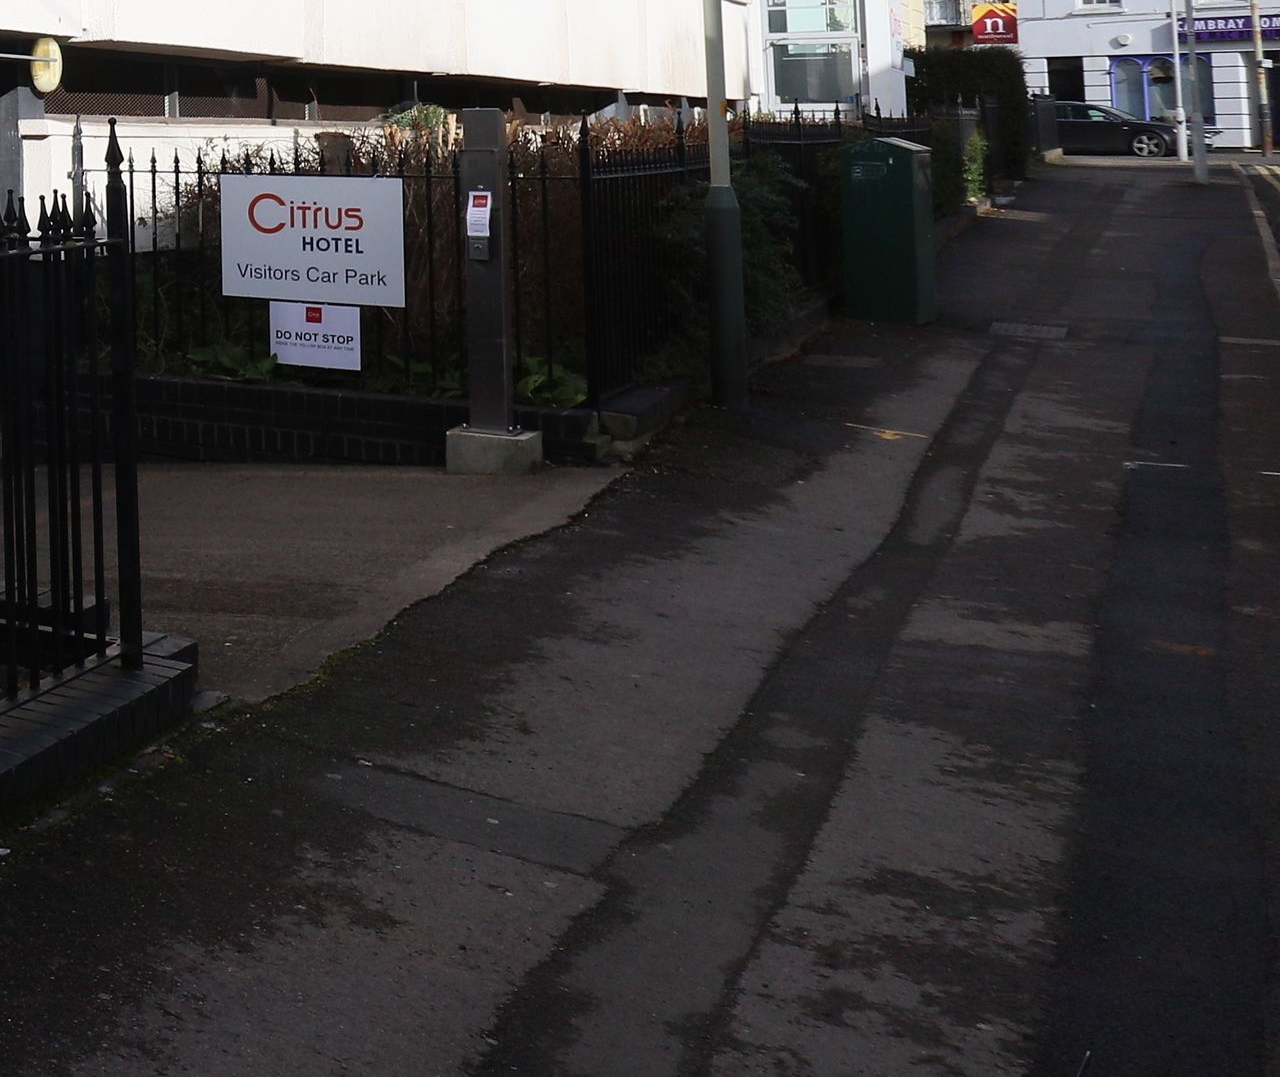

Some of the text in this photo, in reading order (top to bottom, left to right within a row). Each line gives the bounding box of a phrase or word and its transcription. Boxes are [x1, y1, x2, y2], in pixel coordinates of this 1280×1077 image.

[248, 192, 365, 235] Citrus
[301, 236, 364, 254] HOTEL
[237, 262, 388, 287] Visitors Car Park
[275, 329, 354, 346] DO NOT STOP
